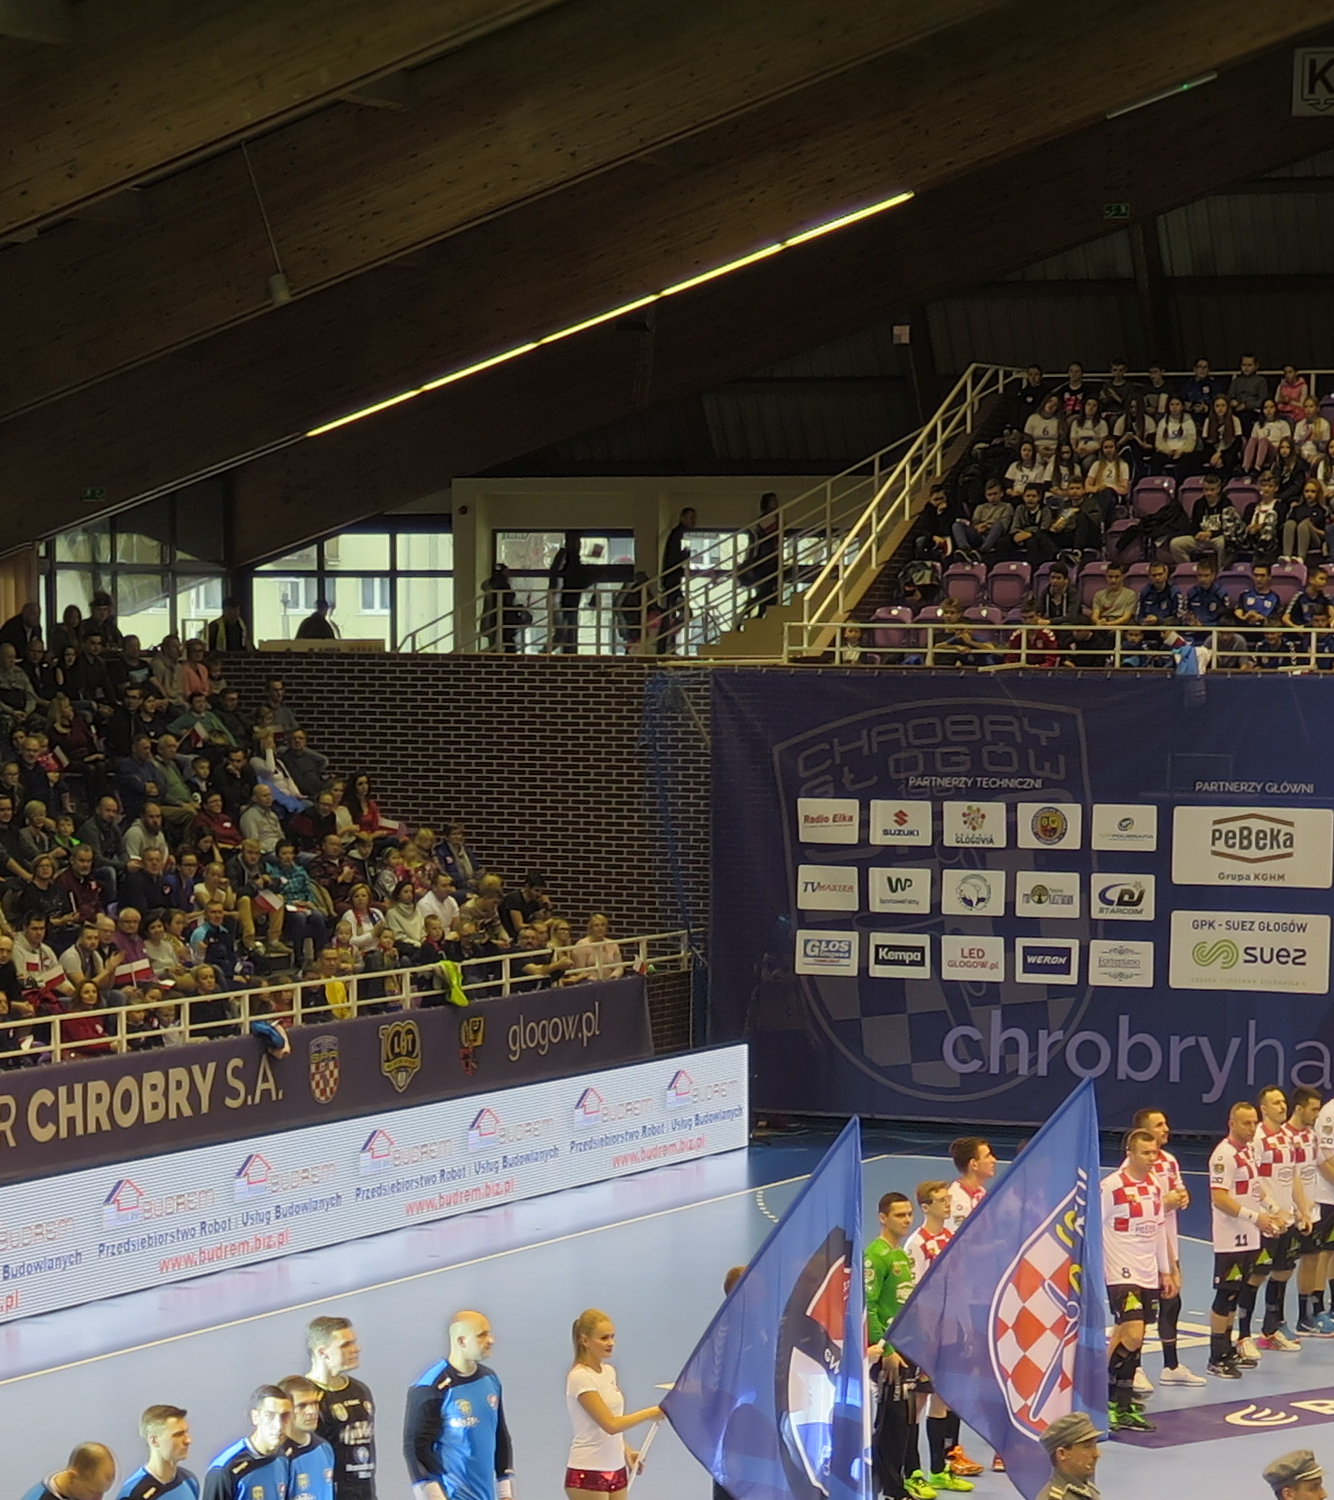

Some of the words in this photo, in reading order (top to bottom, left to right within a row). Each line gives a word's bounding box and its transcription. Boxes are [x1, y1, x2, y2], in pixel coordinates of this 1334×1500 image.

[908, 776, 974, 789] PARTNERZY
[975, 777, 1043, 790] TECHNICZNI
[1195, 781, 1264, 793] PARTNERZY
[1265, 781, 1315, 794] GŁÓWNI
[882, 828, 920, 837] SUZUKI
[1210, 825, 1295, 851] PeBeKa
[1218, 871, 1251, 882] Grupa
[1253, 872, 1286, 882] KGHM
[1097, 906, 1144, 915] STARCOM
[1191, 919, 1216, 931] GPK
[1225, 920, 1256, 932] SUEZ
[1258, 919, 1308, 933] GŁOGÓW
[878, 947, 921, 964] Kempa
[960, 947, 986, 960] LED
[1026, 955, 1067, 965] WERON
[507, 1001, 601, 1062] glogow.pl
[26, 1061, 217, 1143] CHROBRY
[224, 1053, 284, 1109] S.A.
[1234, 1234, 1249, 1248] 11
[1121, 1266, 1132, 1279] 8
